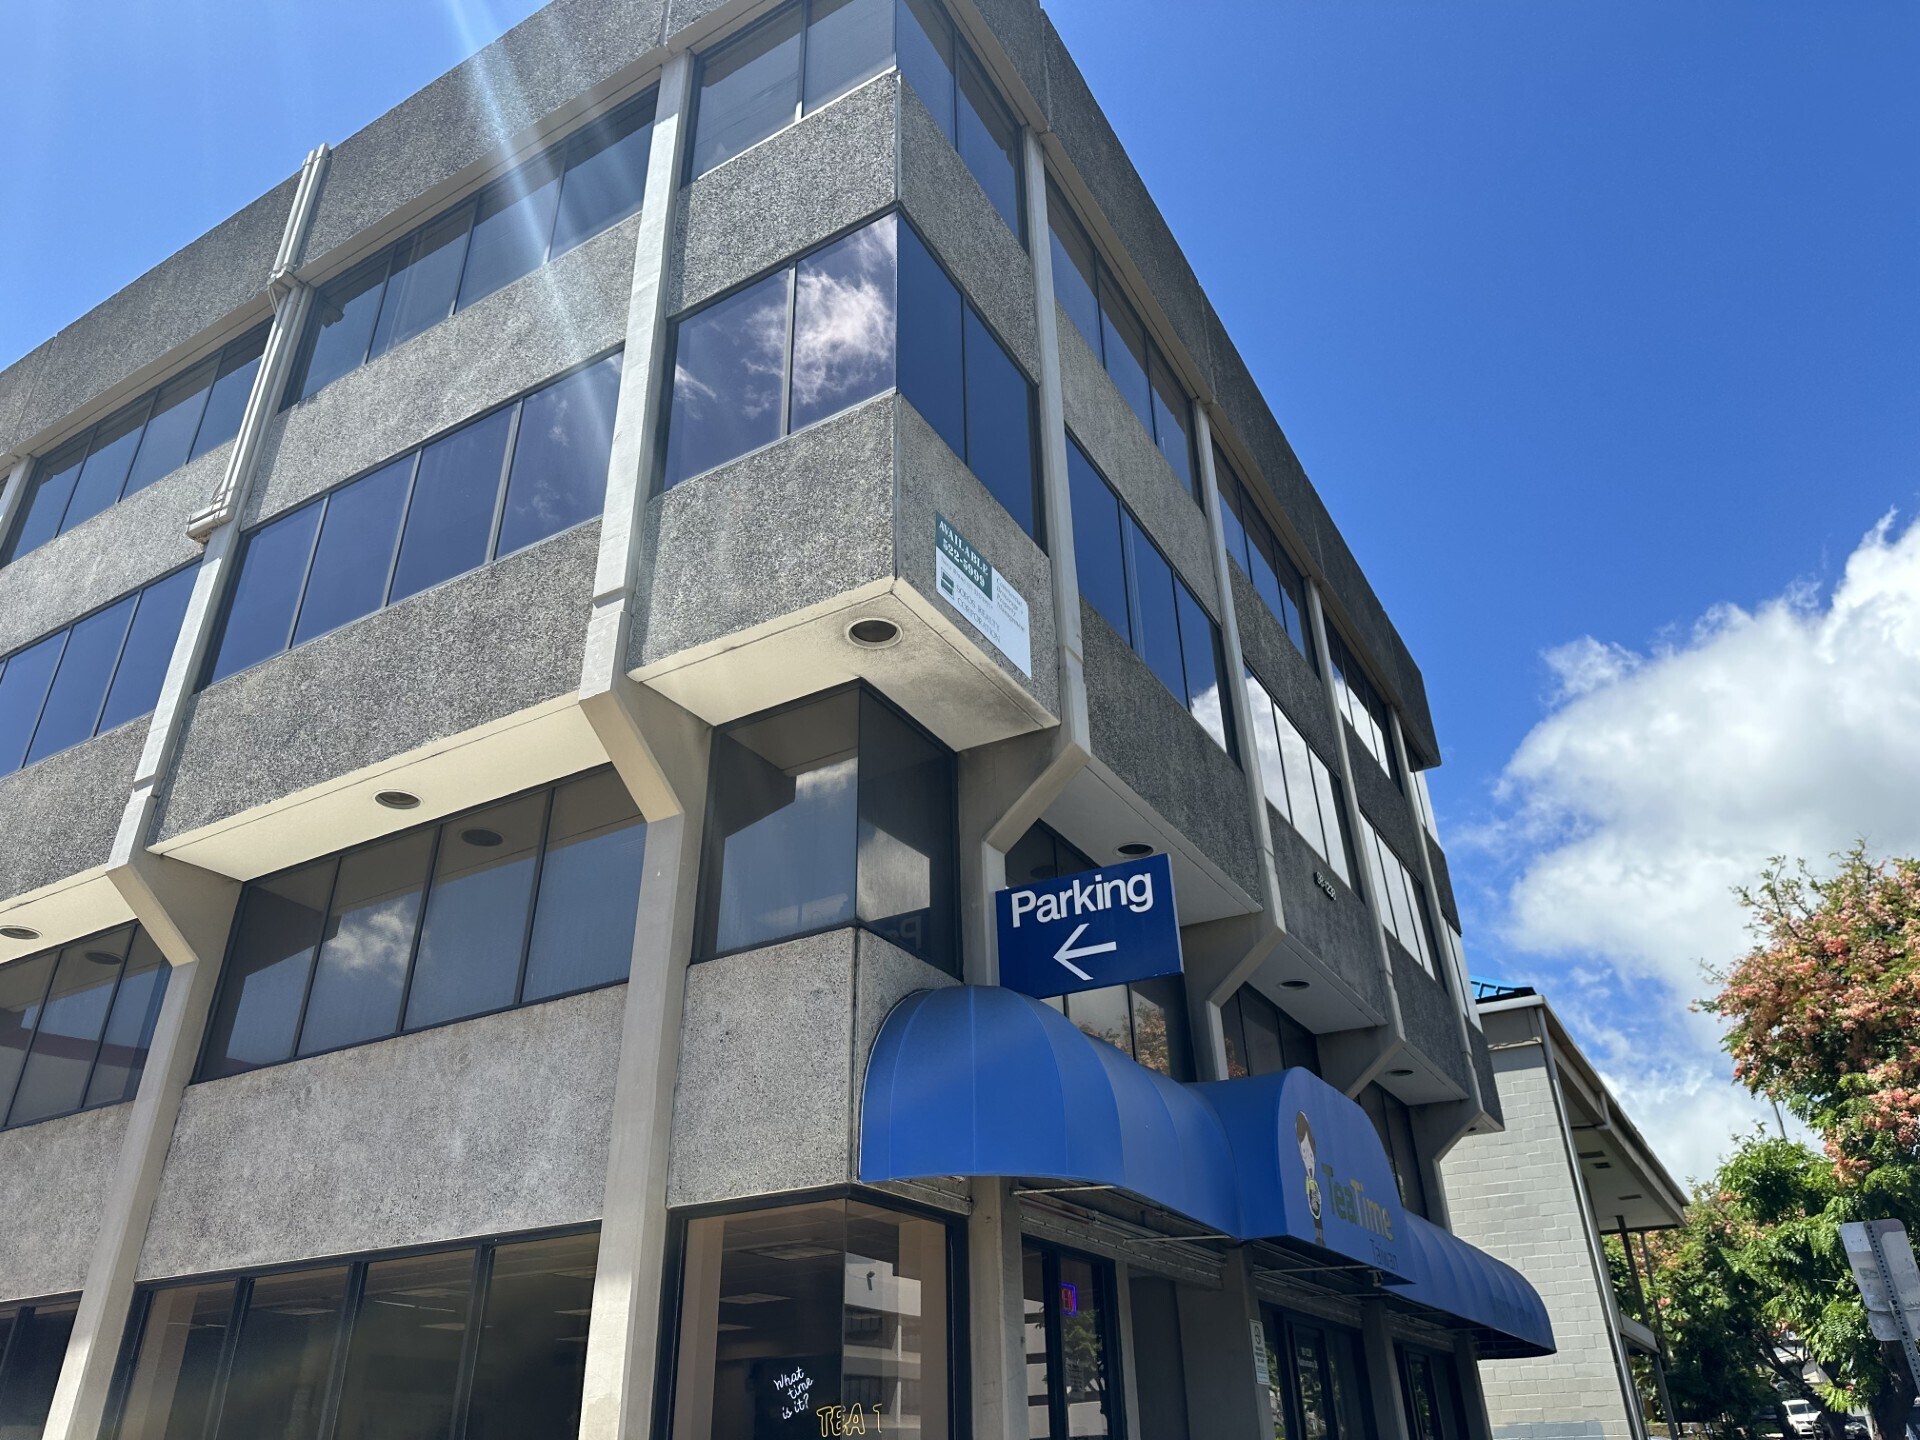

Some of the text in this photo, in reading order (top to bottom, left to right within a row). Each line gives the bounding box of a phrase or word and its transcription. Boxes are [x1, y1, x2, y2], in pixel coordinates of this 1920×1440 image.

[938, 520, 989, 576] AVAILABLE
[942, 538, 985, 588] 522-5999
[1011, 872, 1153, 928] Parking
[773, 1366, 805, 1391] What
[787, 1377, 814, 1400] time
[782, 1393, 810, 1420] is it?
[816, 1402, 866, 1438] TEA
